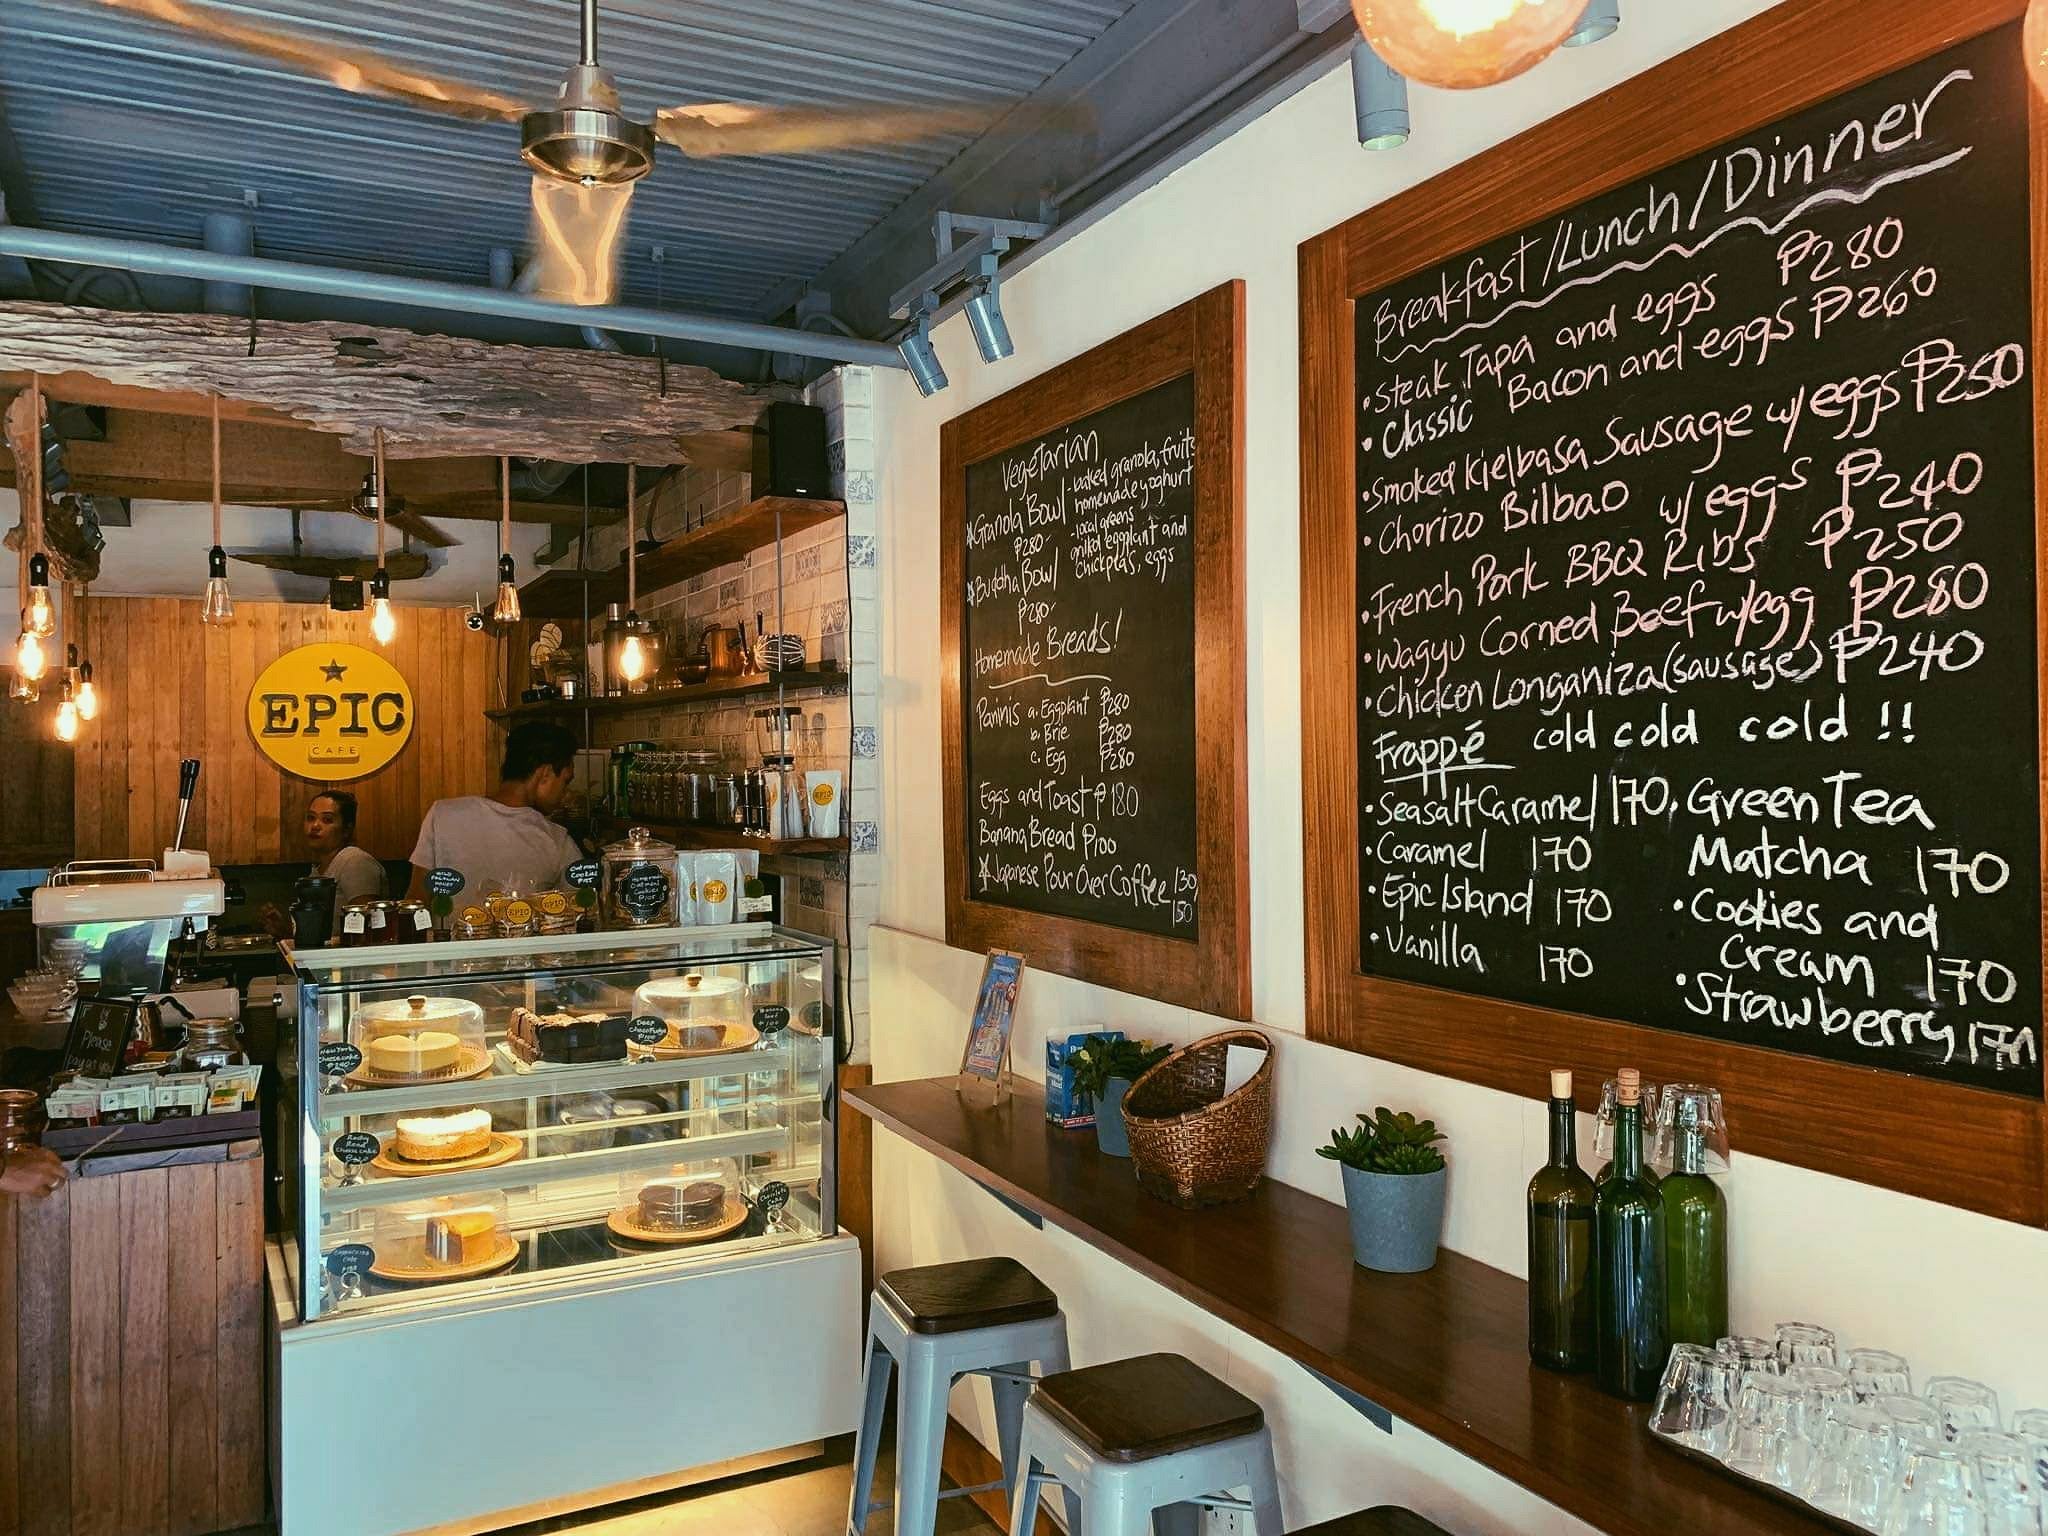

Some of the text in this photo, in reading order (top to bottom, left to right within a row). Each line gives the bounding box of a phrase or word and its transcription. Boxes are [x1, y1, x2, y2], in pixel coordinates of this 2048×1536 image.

[1459, 335, 1536, 389] Tapa
[1555, 304, 1617, 349] and
[1631, 273, 1718, 335] eggs
[1382, 394, 1473, 459] Classic
[1508, 363, 1608, 414] Bacon
[1619, 330, 1683, 379] and
[1693, 297, 1798, 366] eggs
[1002, 427, 1100, 501] Vegetarian
[1366, 461, 1456, 513] Smoked
[1465, 434, 1589, 492] Kielbasa
[1593, 403, 1753, 474] Sausage
[974, 476, 1066, 550] Granola Bowl
[1075, 459, 1194, 516] homemade yoghurt
[1100, 505, 1135, 541] greens
[1105, 519, 1159, 559] eggplant
[1161, 514, 1187, 539] and
[1378, 507, 1485, 554] Chorizo
[974, 546, 1059, 608] Buddha Bowl
[1145, 546, 1175, 584] eggs
[1370, 571, 1463, 635] French
[1471, 547, 1550, 606] Pork
[1564, 538, 1648, 589] BBQ
[1663, 528, 1760, 580] Ribs
[975, 607, 1123, 679] Homemade Breads!
[1479, 600, 1600, 657] Corned
[1610, 580, 1722, 649] Beef
[260, 692, 405, 737] EPIC
[975, 695, 1021, 732] Paninis
[1041, 688, 1090, 725] Eggplant
[1376, 676, 1483, 720] Chicken
[312, 746, 356, 755] CAFE
[1043, 722, 1071, 745] Brie
[1045, 746, 1067, 775] Egg
[1372, 719, 1486, 800] Frappé
[1533, 709, 1596, 752] cold
[1613, 702, 1699, 748] cold
[1739, 692, 1849, 742] cold
[979, 781, 1010, 819] Eggs
[1017, 778, 1042, 809] and
[1043, 775, 1093, 818] Toast
[1687, 769, 1937, 832] Green Tea
[978, 818, 1028, 853] Banana
[1028, 815, 1075, 851] Bread
[1376, 828, 1593, 873] Caramel 170
[1687, 825, 2010, 899] Matcha 170
[992, 853, 1040, 894] Japanese
[1043, 851, 1074, 894] Pour
[1075, 863, 1107, 898] Over
[1109, 862, 1171, 907] Coffee
[1382, 871, 1613, 928] Epic Island 170
[1172, 899, 1192, 928] 150
[1691, 887, 1939, 951] Cookies and
[1386, 920, 1594, 984] Vanilla 170
[1720, 933, 2018, 1006] Cream 170
[1684, 973, 1955, 1065] Strawberry
